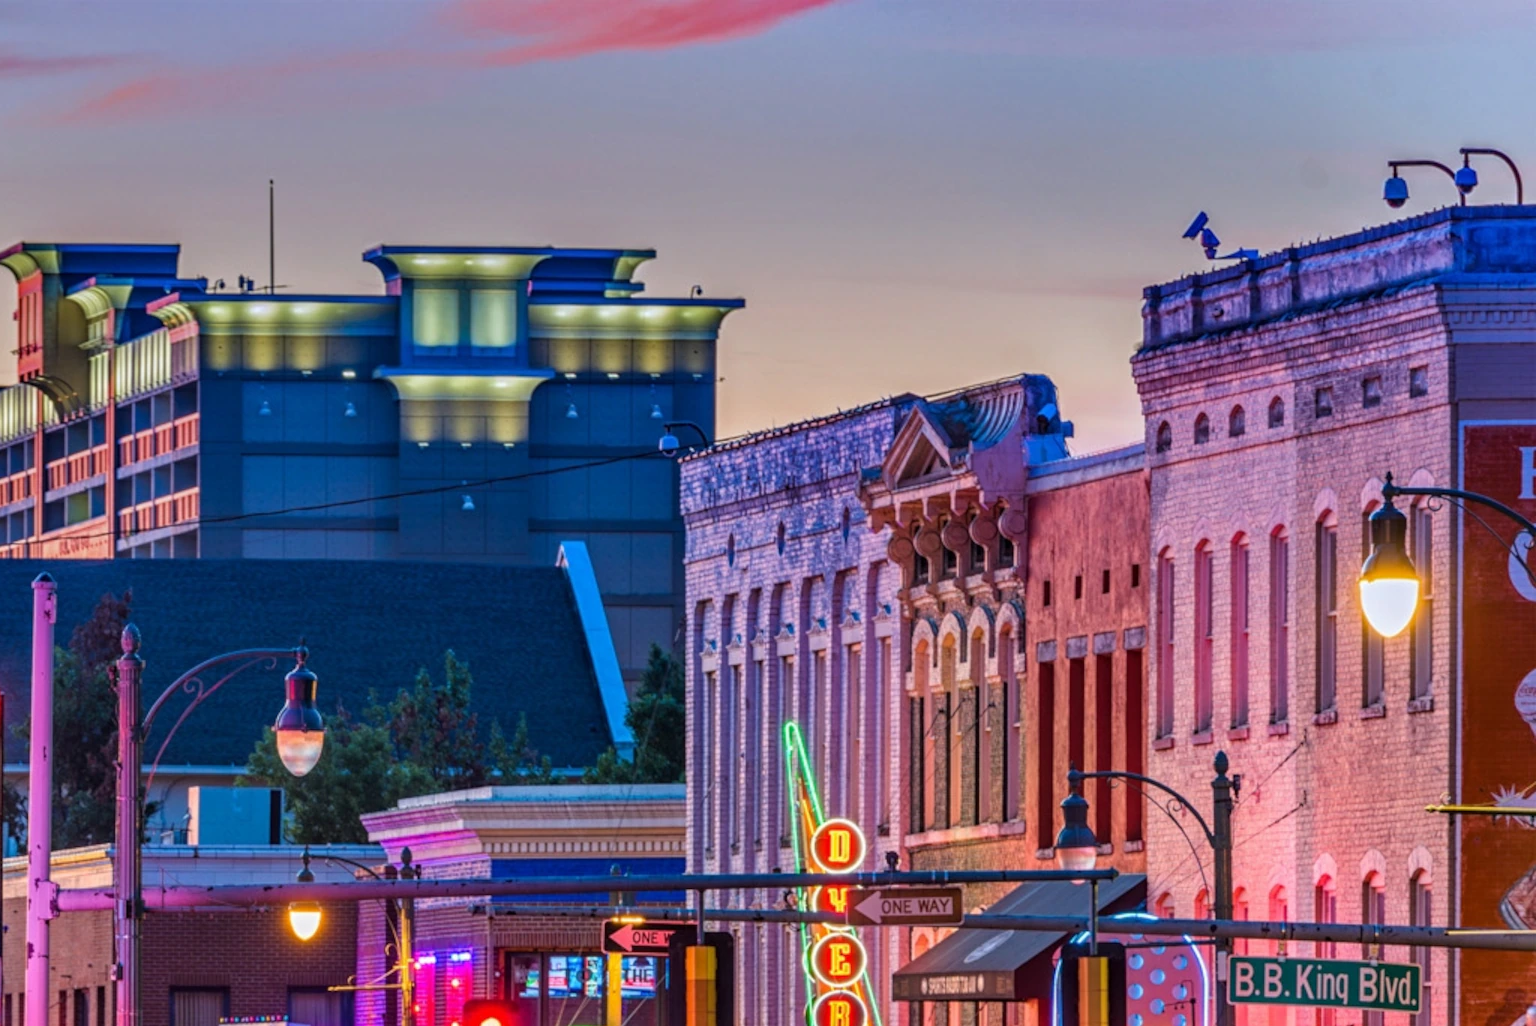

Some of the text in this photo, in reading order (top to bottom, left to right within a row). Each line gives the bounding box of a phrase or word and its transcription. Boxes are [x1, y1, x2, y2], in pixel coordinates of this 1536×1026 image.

[881, 897, 952, 914] ONE WAY
[632, 931, 658, 944] ONE
[1235, 961, 1418, 1007] B.B. King Blvd.
